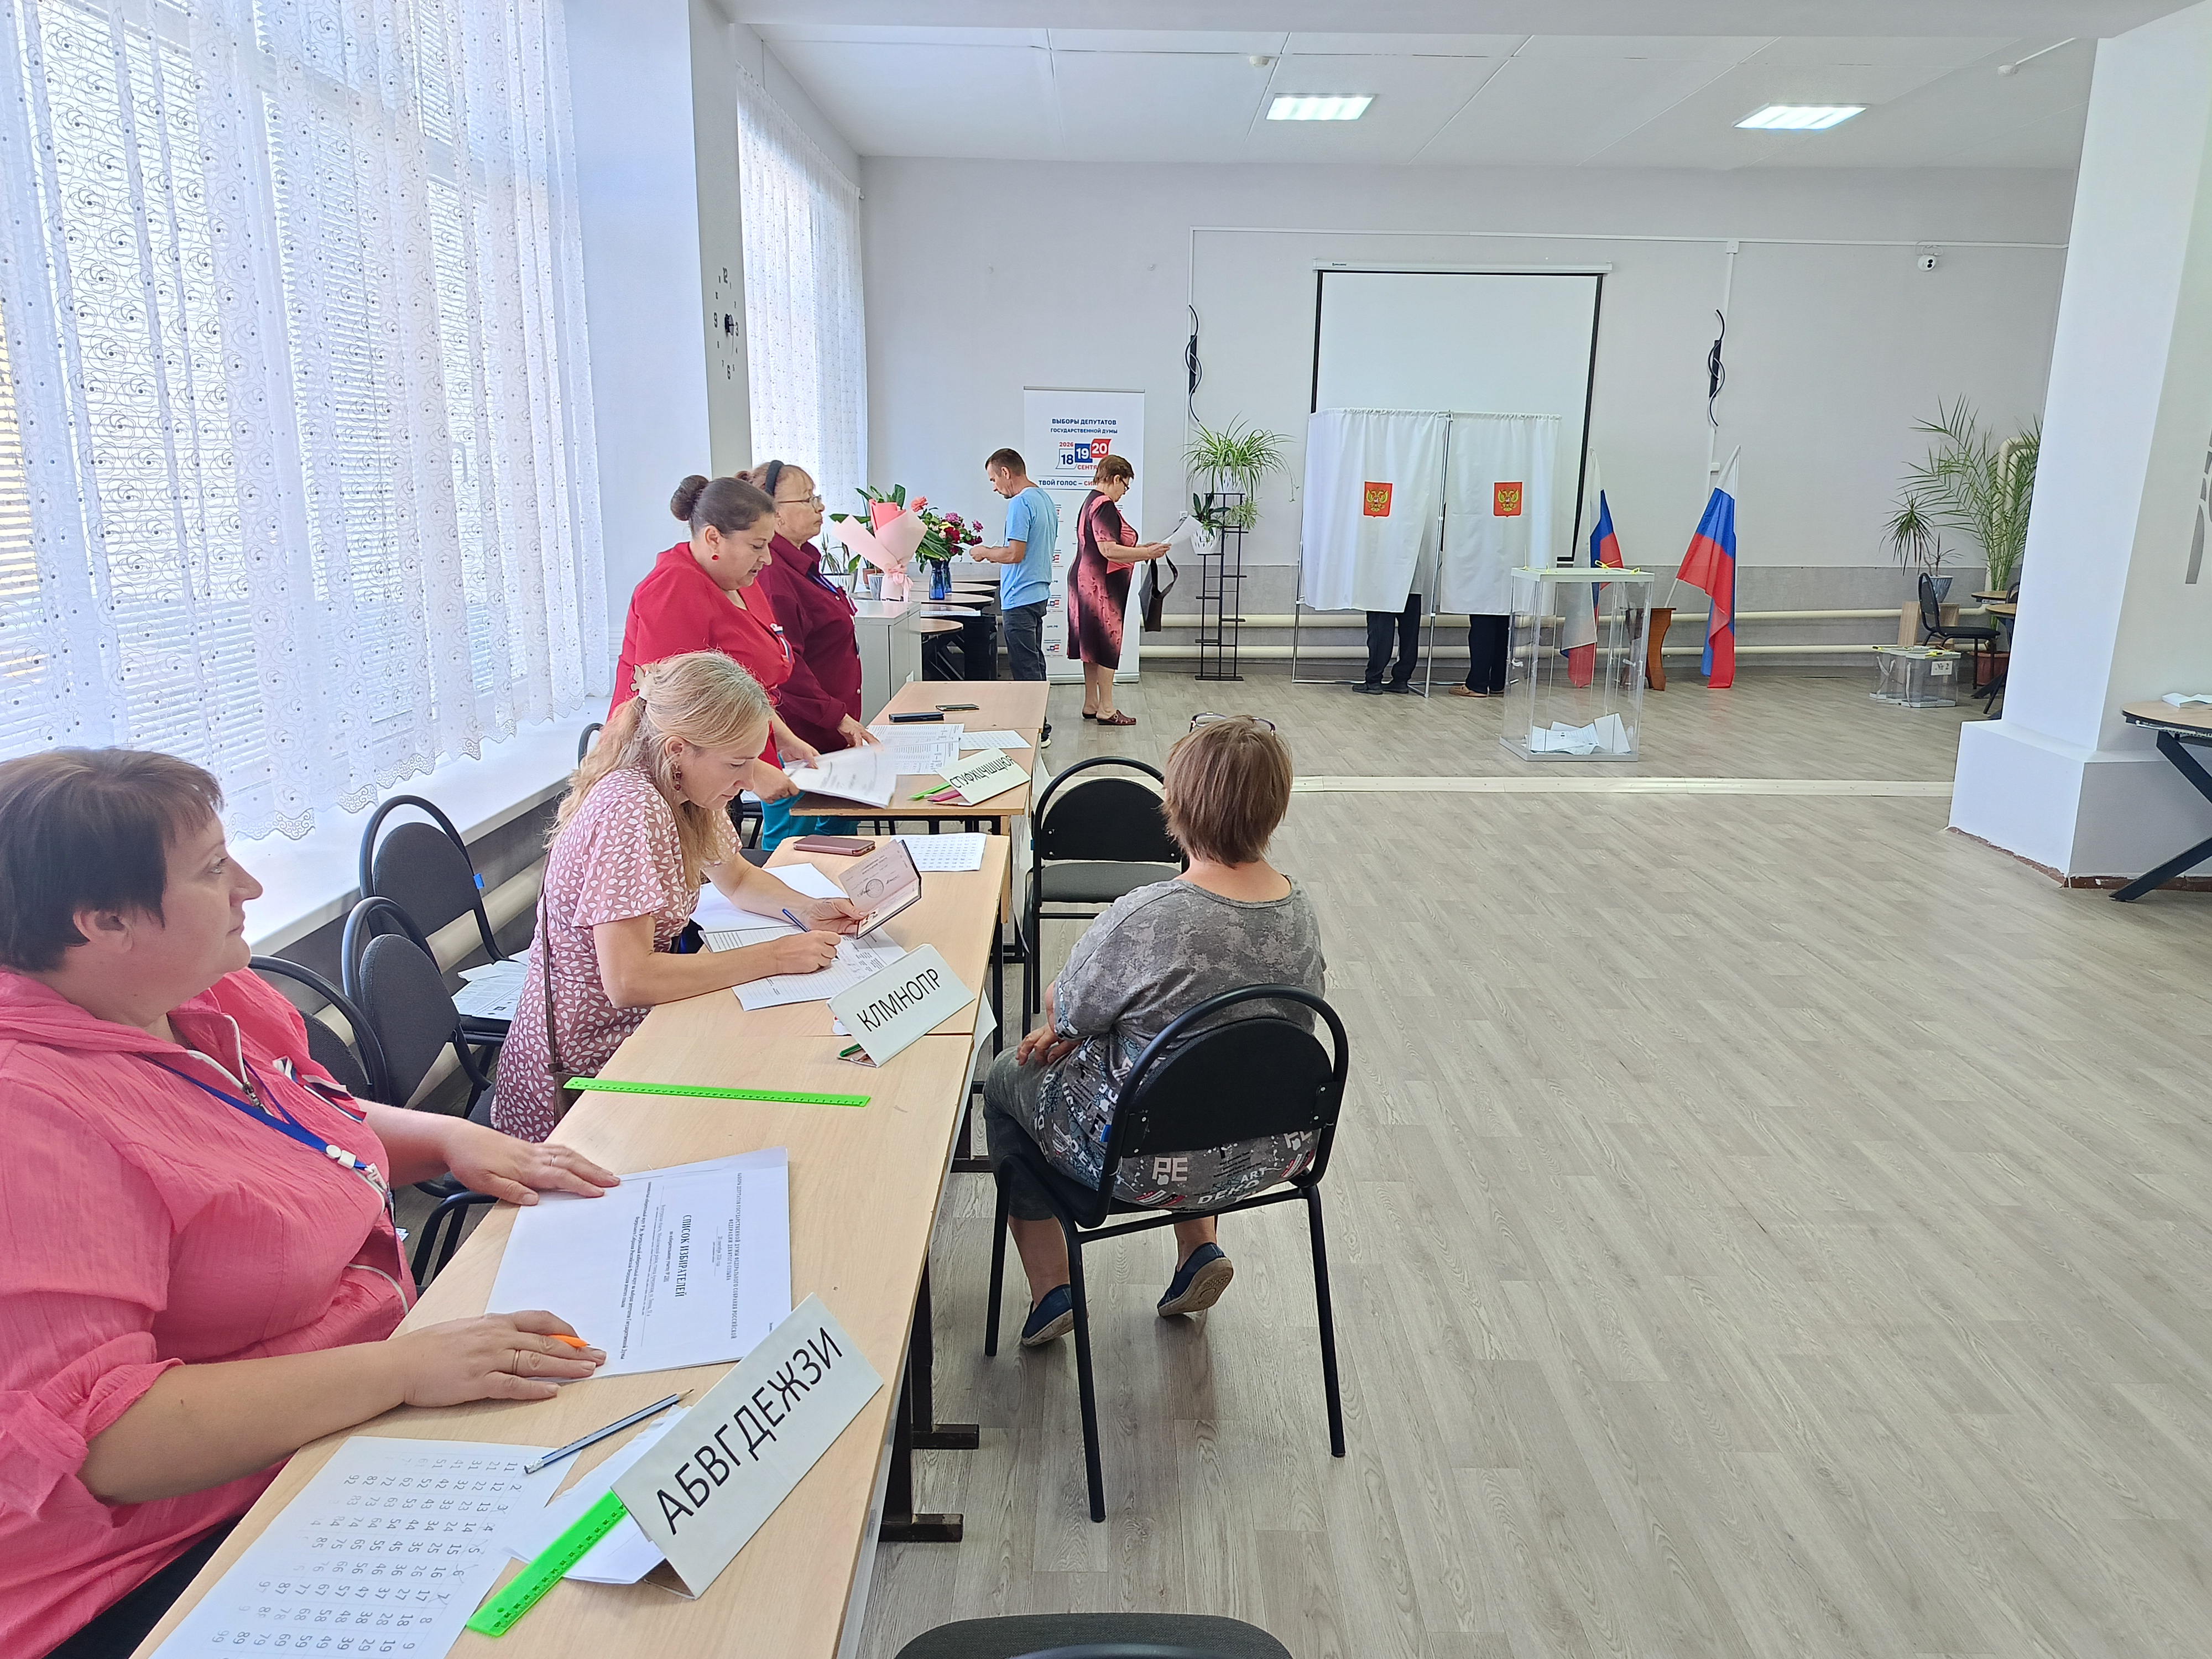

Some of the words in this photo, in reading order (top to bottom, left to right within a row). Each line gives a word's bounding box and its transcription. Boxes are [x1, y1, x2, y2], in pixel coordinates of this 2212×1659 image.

[714, 312, 718, 328] 9
[735, 321, 739, 337] 3
[727, 365, 731, 380] 6
[1061, 455, 1074, 465] 18
[1076, 448, 1089, 460] 19
[1092, 443, 1108, 454] 20
[857, 968, 940, 1032] КЛМНОПР
[1240, 1167, 1267, 1183] ART
[1197, 1180, 1260, 1204] DEKO
[680, 1215, 692, 1244] СПИСОК
[675, 1245, 690, 1297] ИЗБИРАТЕЛЕЙ
[656, 1327, 843, 1535] АБВГДЕЖЗИ
[432, 1459, 447, 1469] 51
[450, 1459, 463, 1469] 41
[468, 1460, 482, 1470] 31
[486, 1460, 500, 1470] 21
[504, 1462, 518, 1472] 11
[344, 1475, 359, 1484] 92
[362, 1475, 378, 1485] 82
[380, 1477, 396, 1486] 72
[399, 1478, 413, 1487] 62
[417, 1479, 432, 1488] 52
[435, 1479, 449, 1489] 42
[453, 1480, 468, 1490] 32
[472, 1481, 487, 1490] 22
[490, 1481, 504, 1491] 12
[365, 1496, 380, 1506] 73
[384, 1498, 398, 1507] 63
[402, 1498, 417, 1508] 53
[421, 1499, 435, 1509] 43
[440, 1500, 454, 1510] 33
[458, 1501, 472, 1511] 23
[477, 1502, 491, 1512] 13
[348, 1517, 364, 1527] 74
[367, 1517, 382, 1528] 64
[387, 1519, 401, 1529] 54
[405, 1519, 419, 1530] 44
[424, 1520, 439, 1531] 34
[443, 1521, 458, 1532] 24
[462, 1522, 477, 1532] 14
[312, 1537, 327, 1548] 85
[332, 1539, 347, 1548] 75
[350, 1539, 365, 1550] 65
[369, 1540, 385, 1551] 55
[389, 1541, 403, 1551] 45
[408, 1541, 423, 1552] 35
[427, 1543, 442, 1553] 25
[447, 1543, 462, 1554] 15
[332, 1561, 348, 1572] 66
[352, 1563, 368, 1574] 56
[372, 1563, 386, 1575] 46
[391, 1564, 407, 1575] 36
[410, 1566, 427, 1577] 26
[431, 1566, 446, 1578] 16
[275, 1582, 290, 1594] 87
[295, 1584, 311, 1594] 77
[315, 1584, 330, 1595] 67
[335, 1585, 350, 1597] 57
[355, 1586, 369, 1598] 47
[375, 1587, 390, 1599] 37
[395, 1588, 410, 1600] 27
[416, 1589, 430, 1601] 17
[274, 1608, 292, 1620] 78
[294, 1608, 310, 1620] 68
[314, 1609, 332, 1621] 58
[335, 1610, 351, 1623] 48
[356, 1611, 373, 1624] 38
[376, 1613, 393, 1625] 28
[397, 1615, 413, 1626] 18
[212, 1630, 229, 1642] 99
[233, 1632, 250, 1644] 89
[254, 1634, 271, 1645] 79
[275, 1634, 290, 1646] 69
[295, 1636, 312, 1647] 59
[316, 1636, 332, 1648] 49
[337, 1637, 354, 1650] 39
[358, 1639, 375, 1651] 29
[379, 1640, 395, 1652] 19
